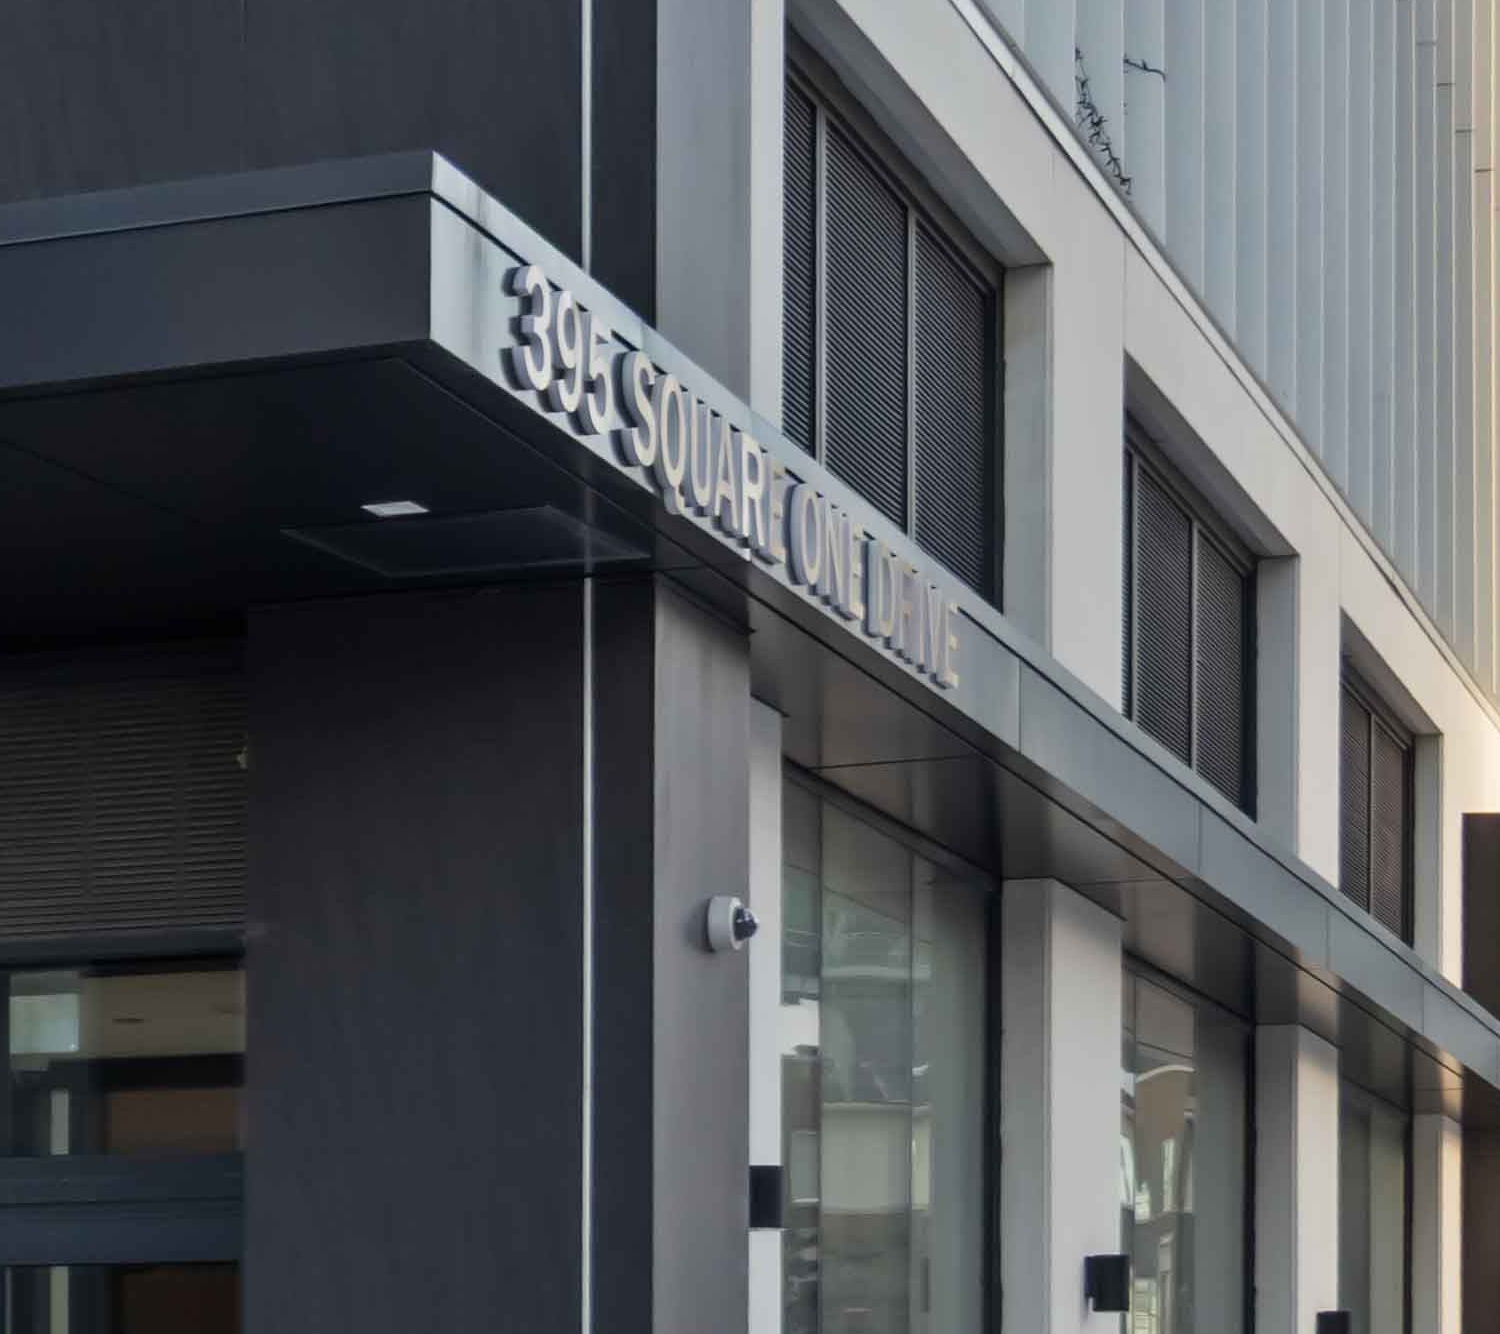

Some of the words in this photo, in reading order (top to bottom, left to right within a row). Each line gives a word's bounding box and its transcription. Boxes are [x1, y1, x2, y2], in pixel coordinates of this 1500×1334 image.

[501, 265, 612, 437] 395
[610, 351, 788, 565] SQUARE
[787, 481, 865, 621] ONE
[861, 538, 960, 690] DRIVE
